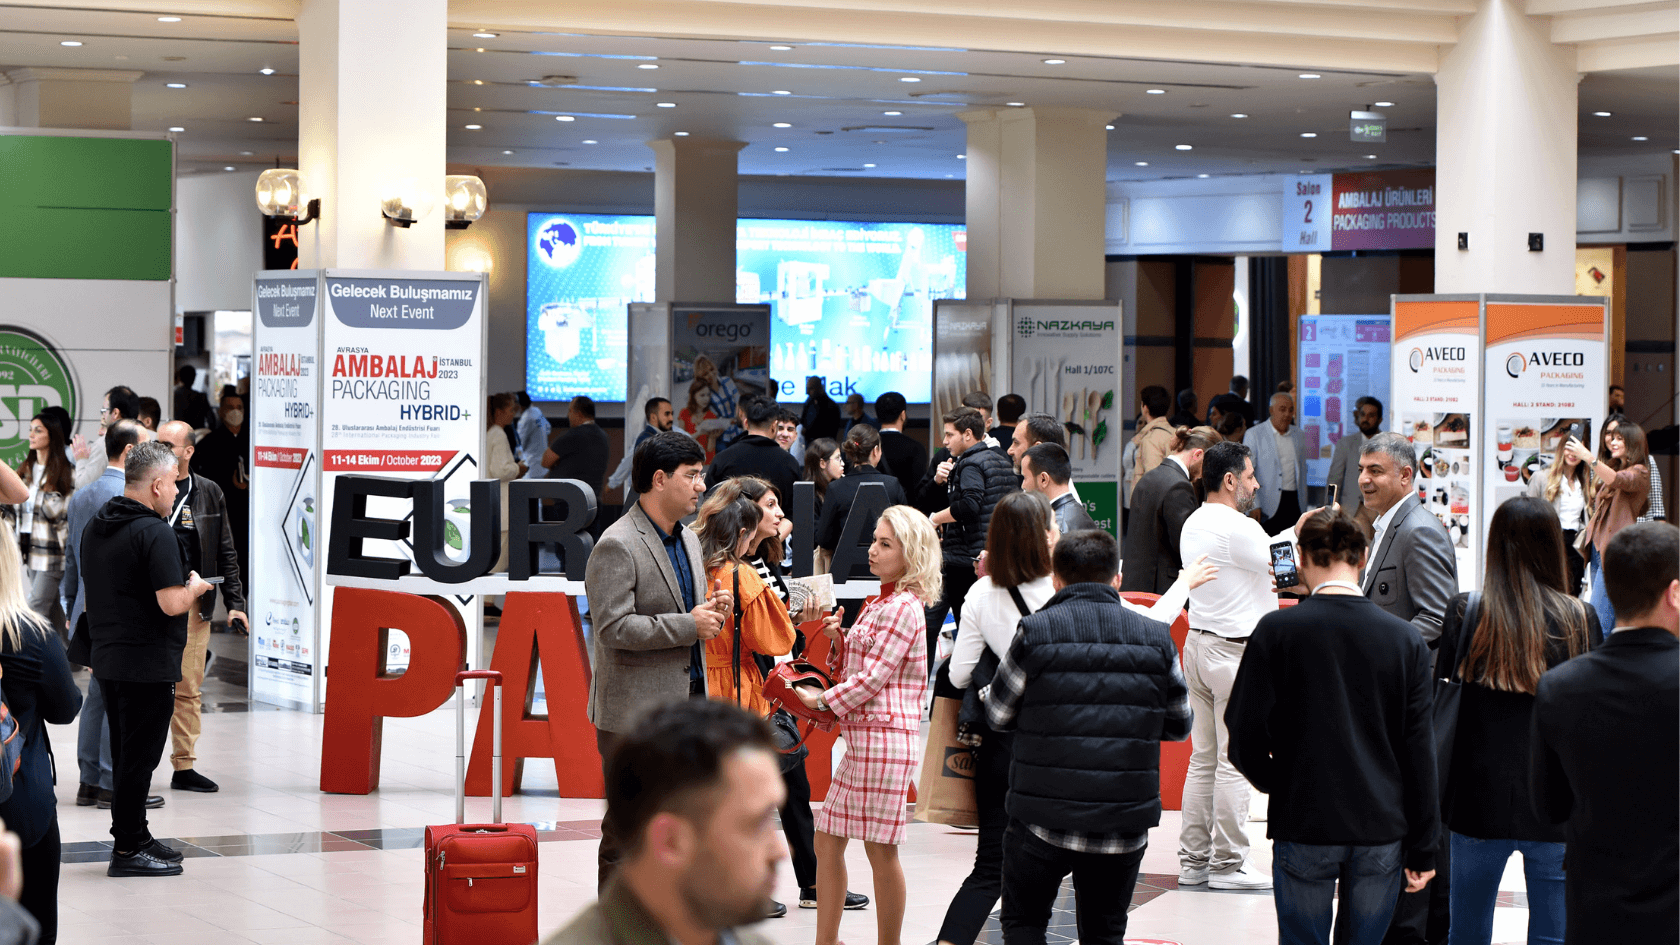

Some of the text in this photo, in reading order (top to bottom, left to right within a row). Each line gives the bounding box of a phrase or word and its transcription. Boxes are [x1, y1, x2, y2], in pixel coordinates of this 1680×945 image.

[1296, 181, 1320, 196] Salon
[1338, 186, 1433, 208] AMBALAJ ÜRÜNLERİ
[1304, 200, 1312, 223] 2
[1334, 211, 1436, 230] PACKAGING PRODUCTS
[1300, 230, 1317, 245] Hall
[258, 284, 316, 300] Gelecek Buluşmamız
[331, 284, 472, 302] Gelecek Buluşmamız
[273, 304, 300, 317] Next Event
[370, 304, 434, 320] Next Event
[696, 324, 751, 342] orego
[1037, 320, 1114, 330] NAZKAYA
[439, 356, 472, 366] İSTANBUL
[1425, 347, 1466, 360] AVECO
[1528, 352, 1584, 366] AVECO
[258, 353, 300, 376] AMBALAJ
[332, 354, 438, 379] AMBALAJ
[1066, 365, 1114, 376] Hall 1/107C
[438, 370, 458, 379] 2023
[258, 378, 298, 398] PACKAGING
[332, 380, 430, 400] PACKAGING
[284, 402, 314, 418] HYBRID+
[400, 404, 472, 420] HYBRID+
[331, 454, 442, 466] 11-14 Ekim / October 2023
